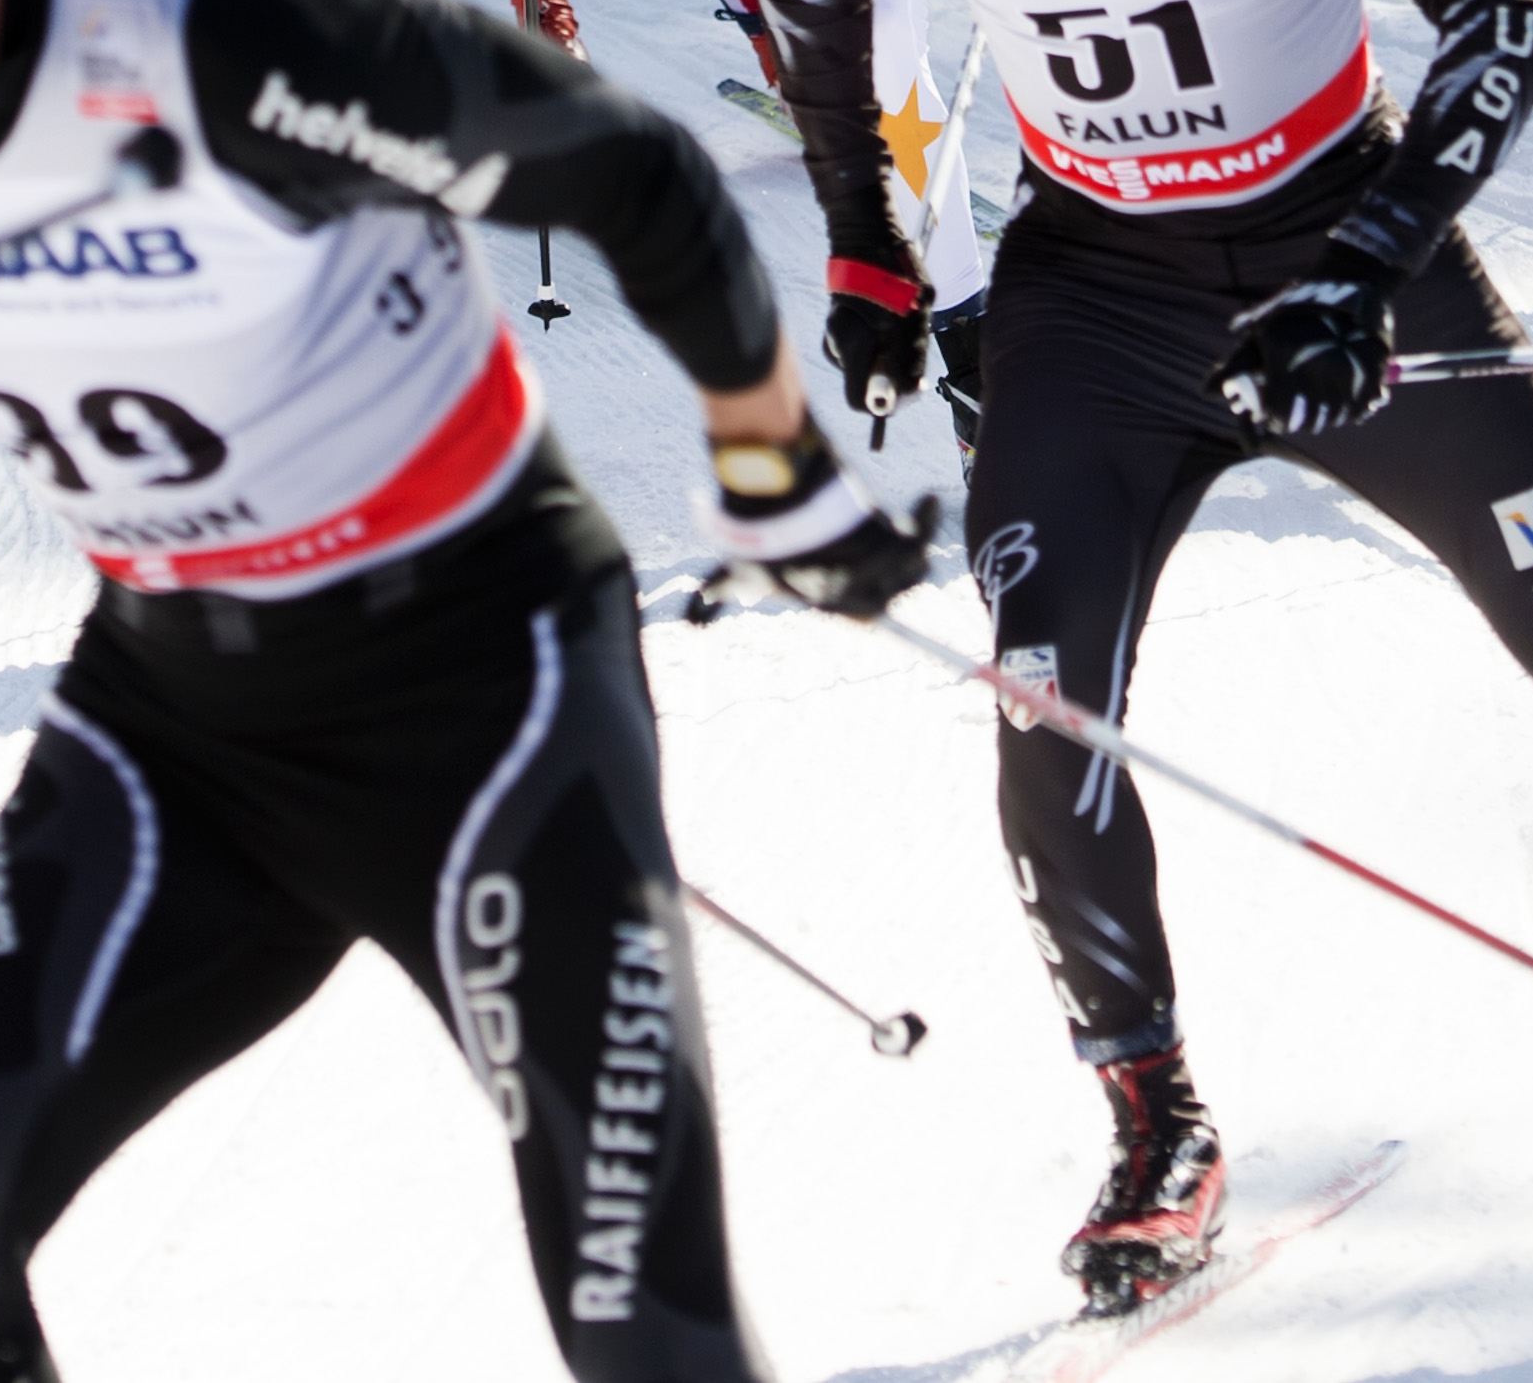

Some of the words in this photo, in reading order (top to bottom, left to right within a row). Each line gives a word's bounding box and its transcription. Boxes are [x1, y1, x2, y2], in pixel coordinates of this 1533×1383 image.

[1023, 0, 1216, 103] 51
[1046, 133, 1286, 201] VIESSMANN
[1055, 104, 1228, 146] FALUN
[573, 921, 674, 1322] RAIFFEISEN
